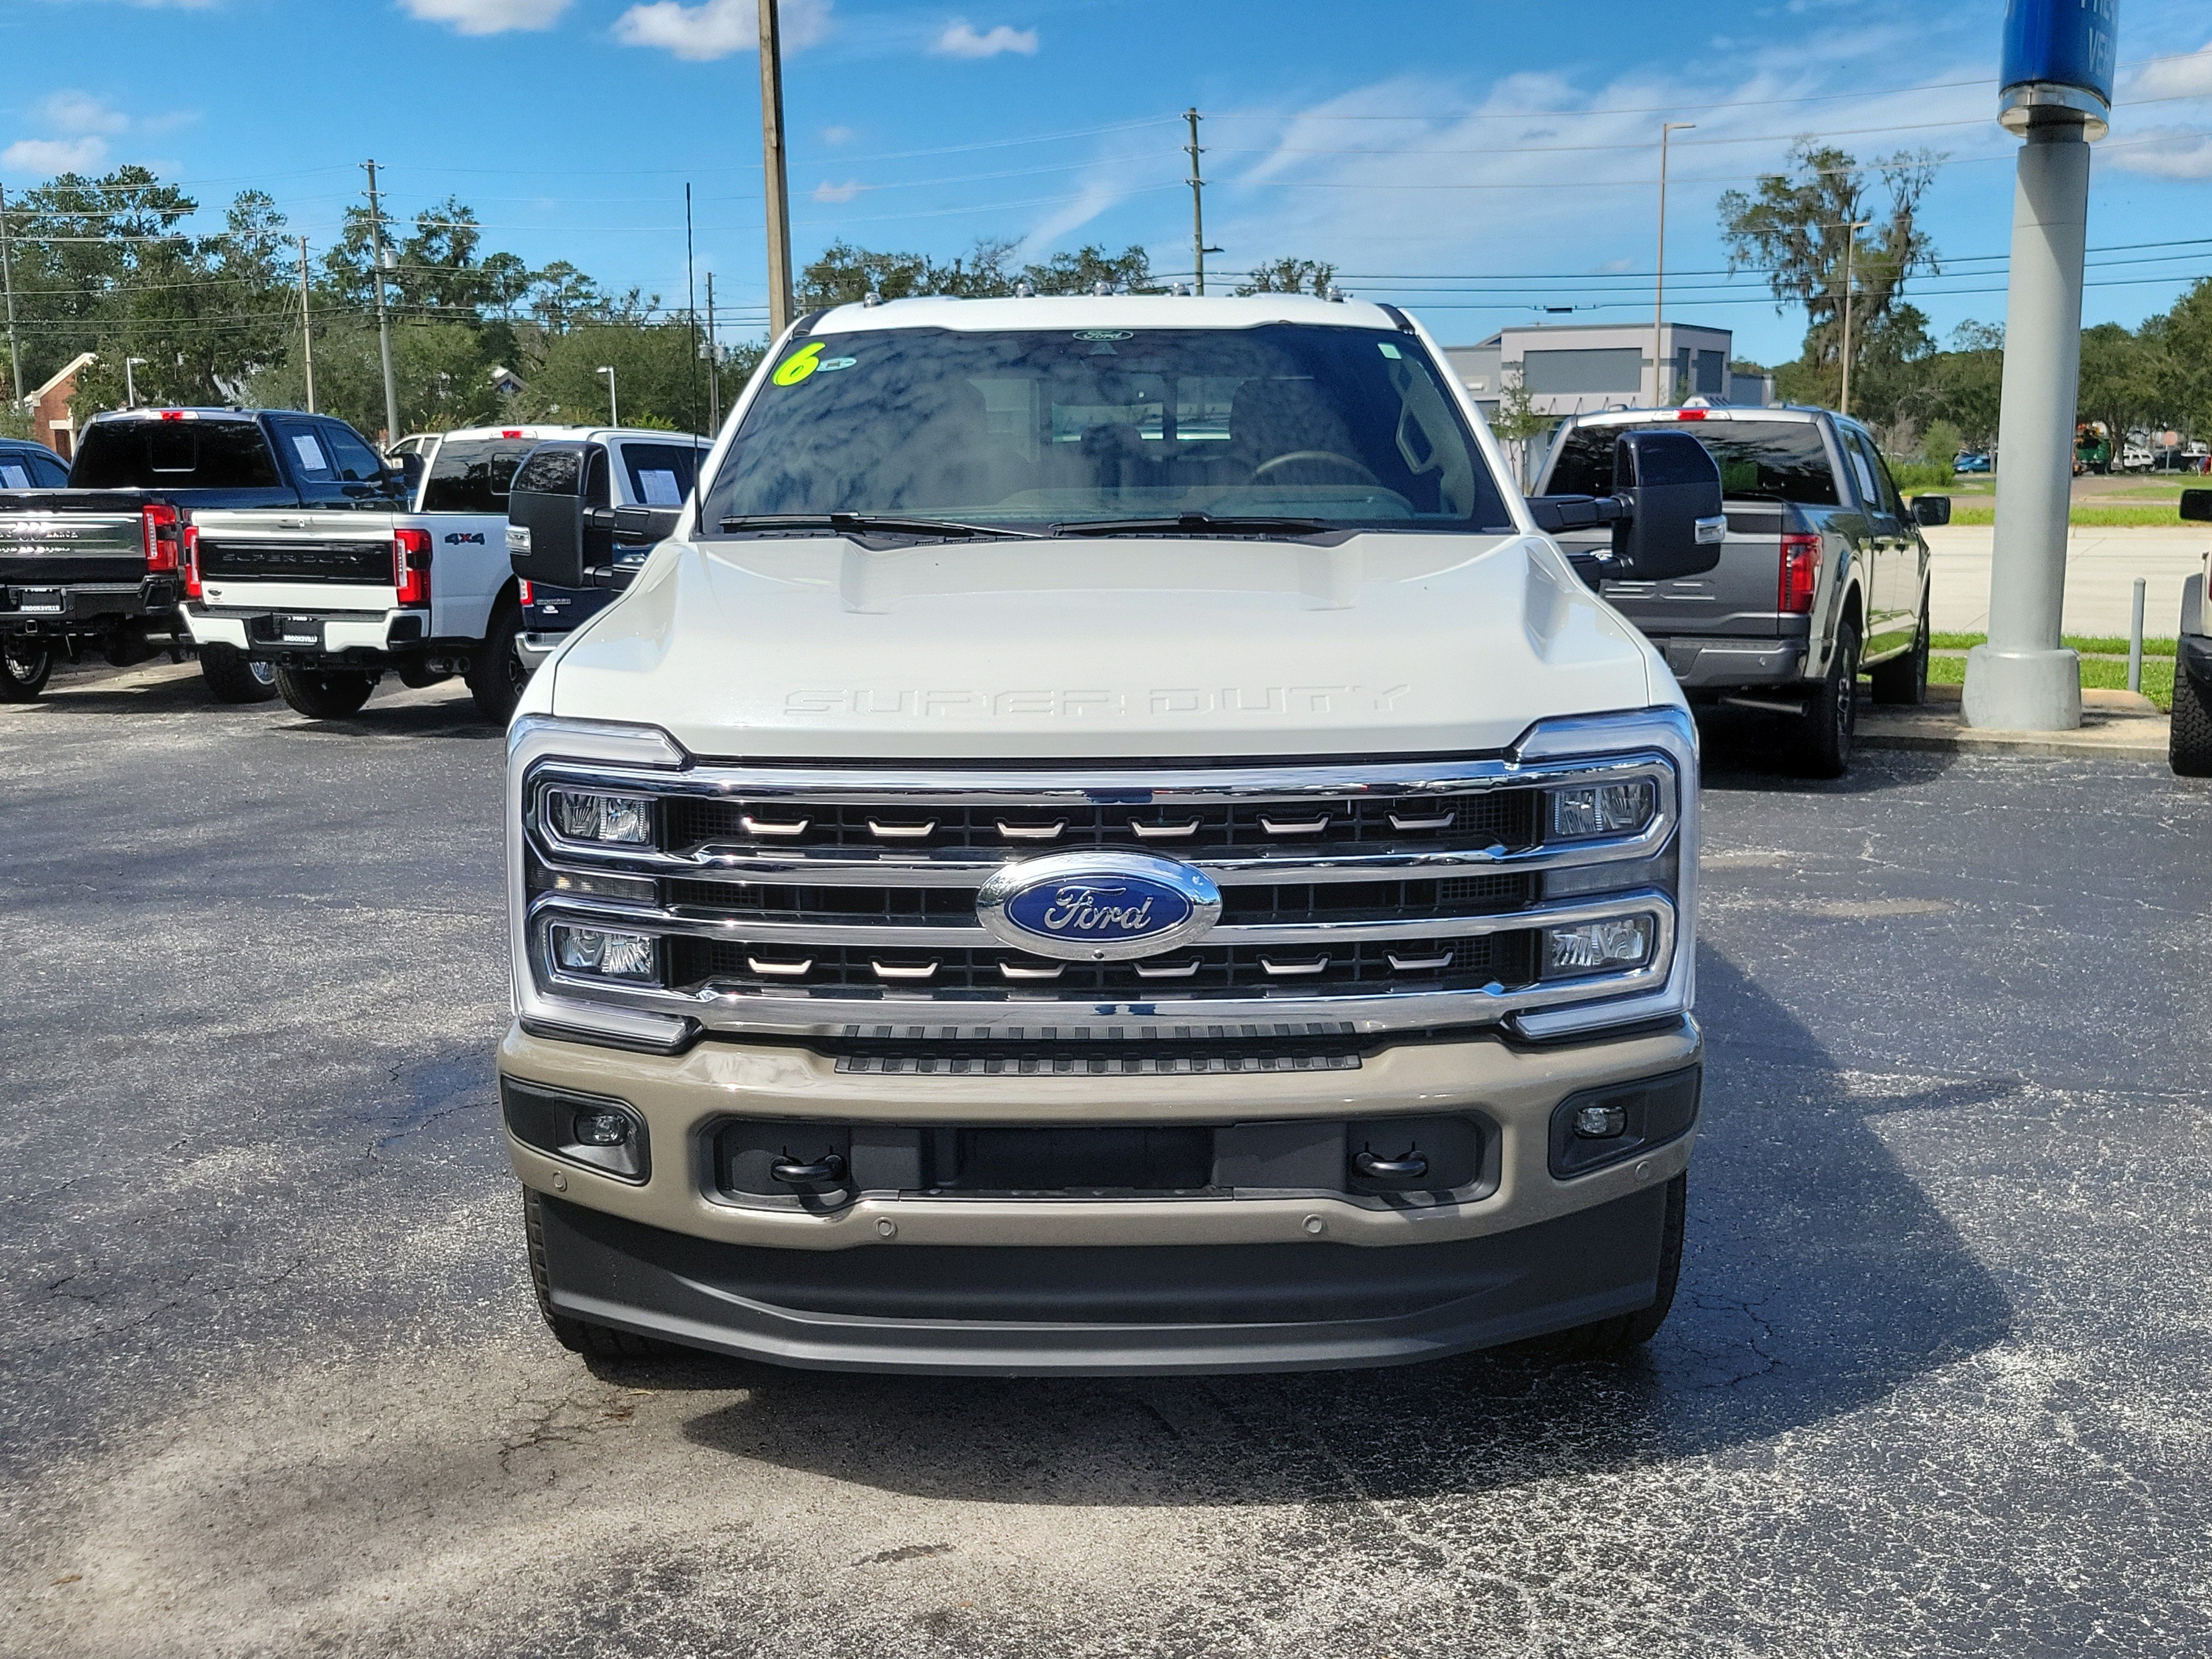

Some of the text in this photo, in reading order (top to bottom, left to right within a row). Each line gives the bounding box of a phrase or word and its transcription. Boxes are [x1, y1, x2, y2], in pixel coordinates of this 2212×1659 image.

[1083, 331, 1123, 339] Ford
[771, 341, 826, 386] 6
[223, 552, 297, 563] SUPER
[783, 684, 1412, 716] SUPER DUTY
[1044, 885, 1153, 929] Ford
